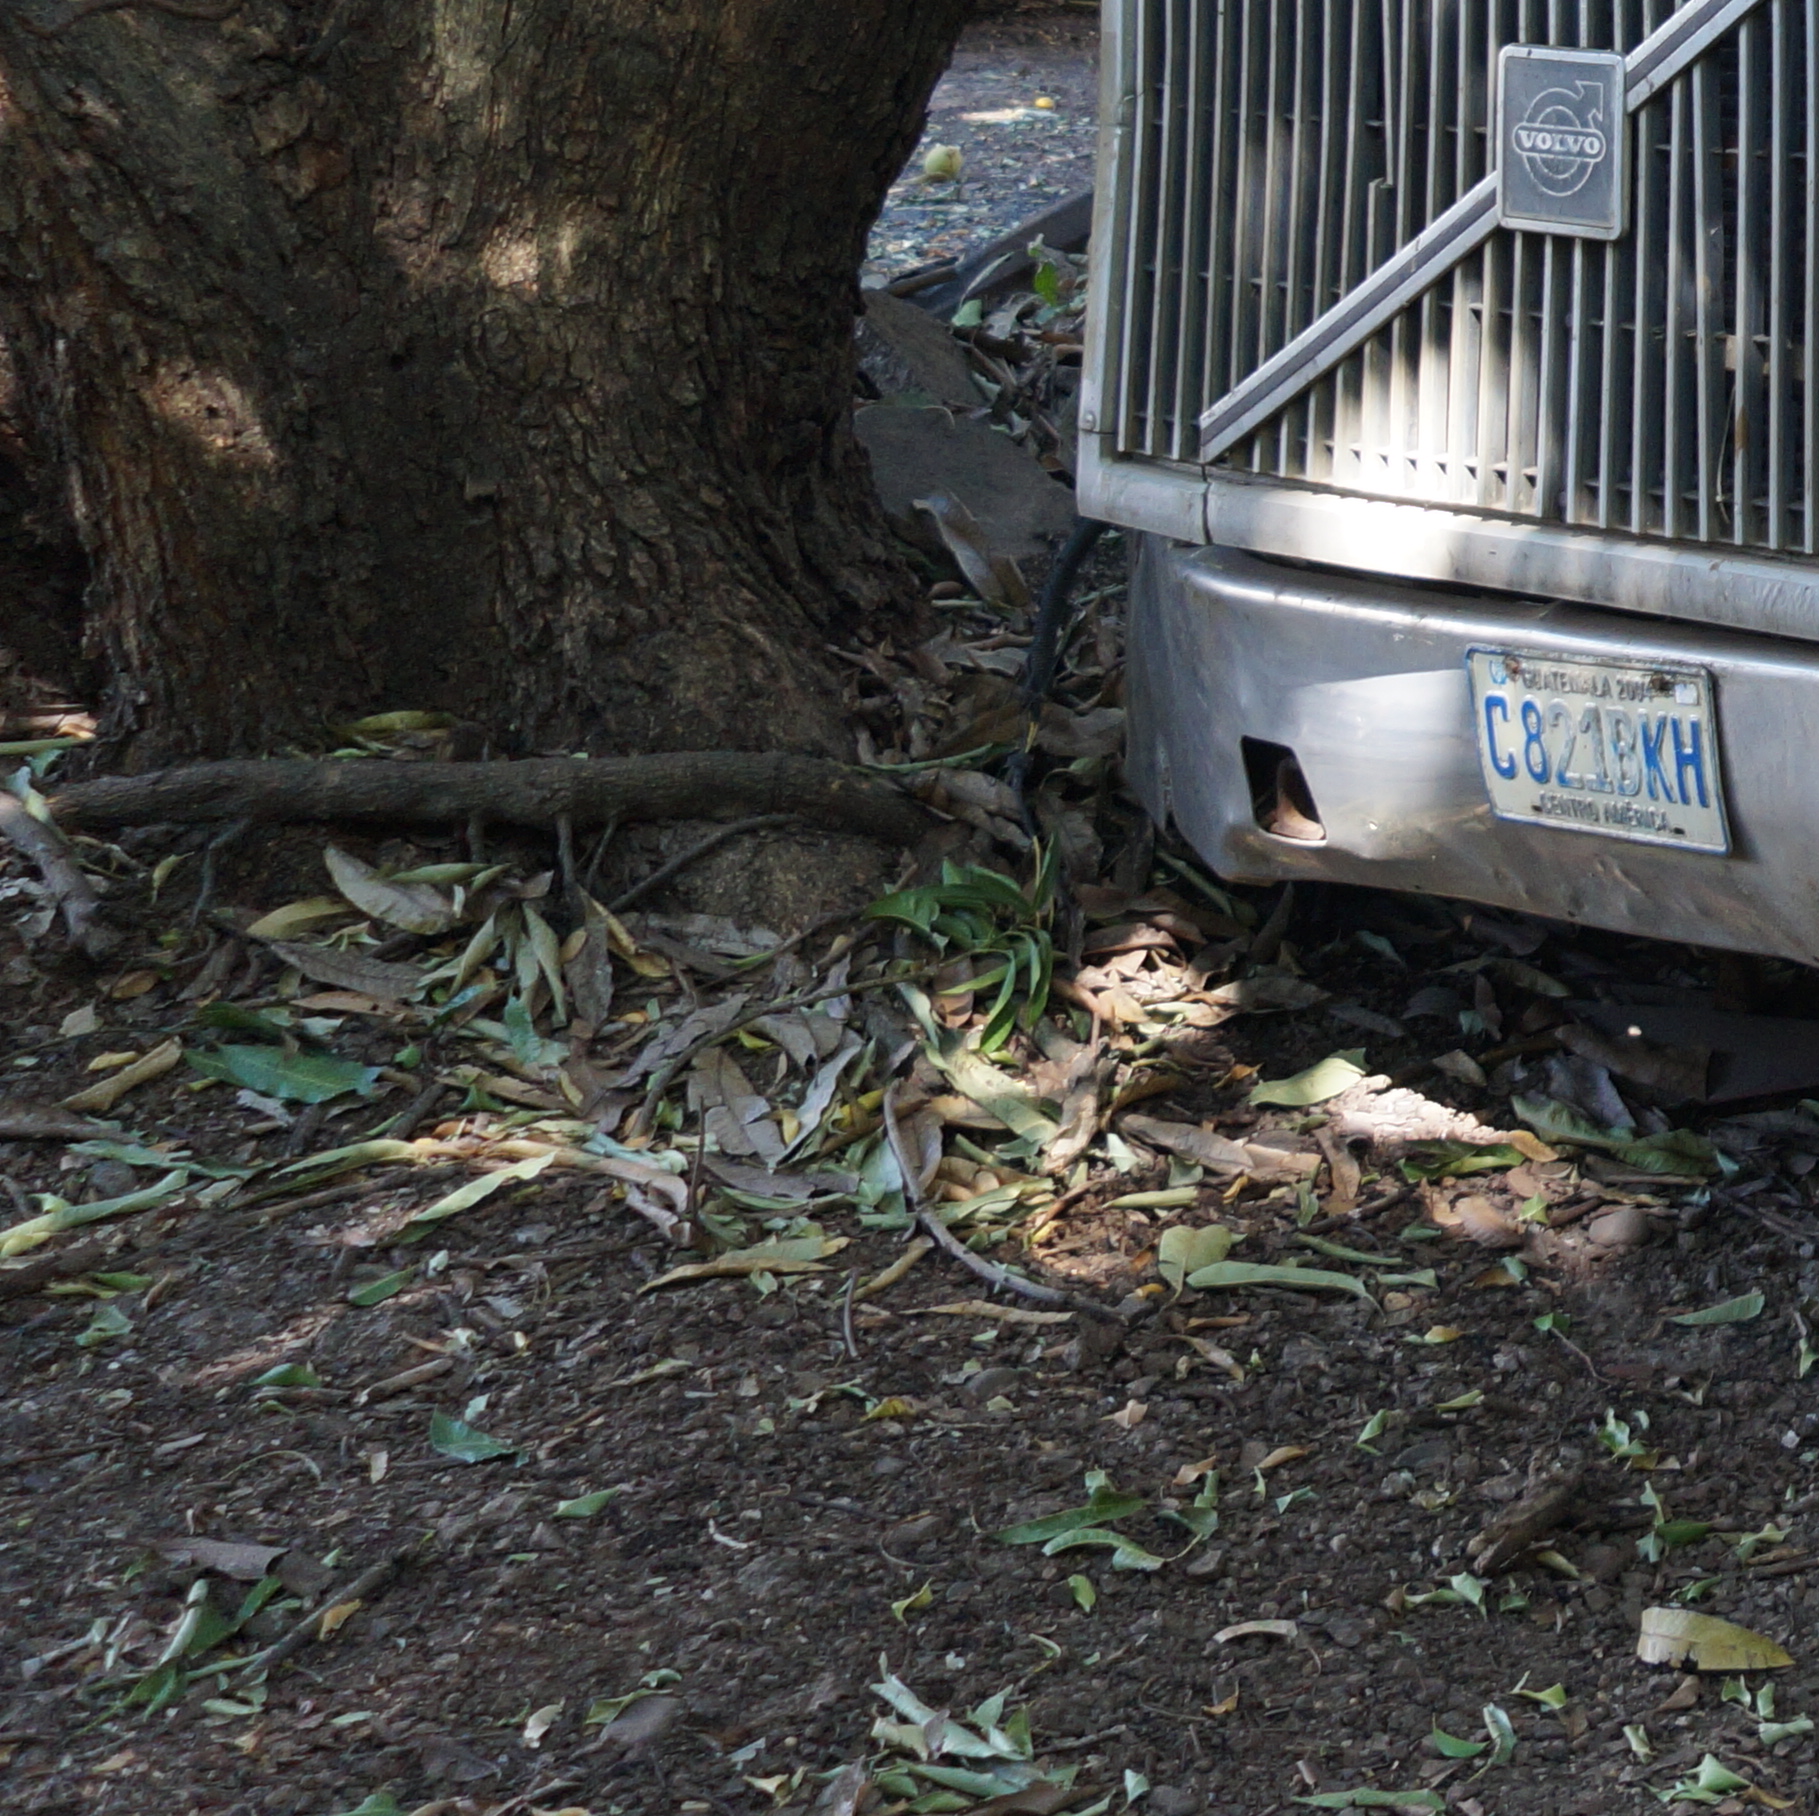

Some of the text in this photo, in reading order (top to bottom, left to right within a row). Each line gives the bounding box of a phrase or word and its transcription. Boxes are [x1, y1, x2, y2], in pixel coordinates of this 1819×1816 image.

[1517, 129, 1601, 155] VOLVO
[1521, 663, 1613, 700] GUATEMALA
[1540, 790, 1600, 823] CENTRO
